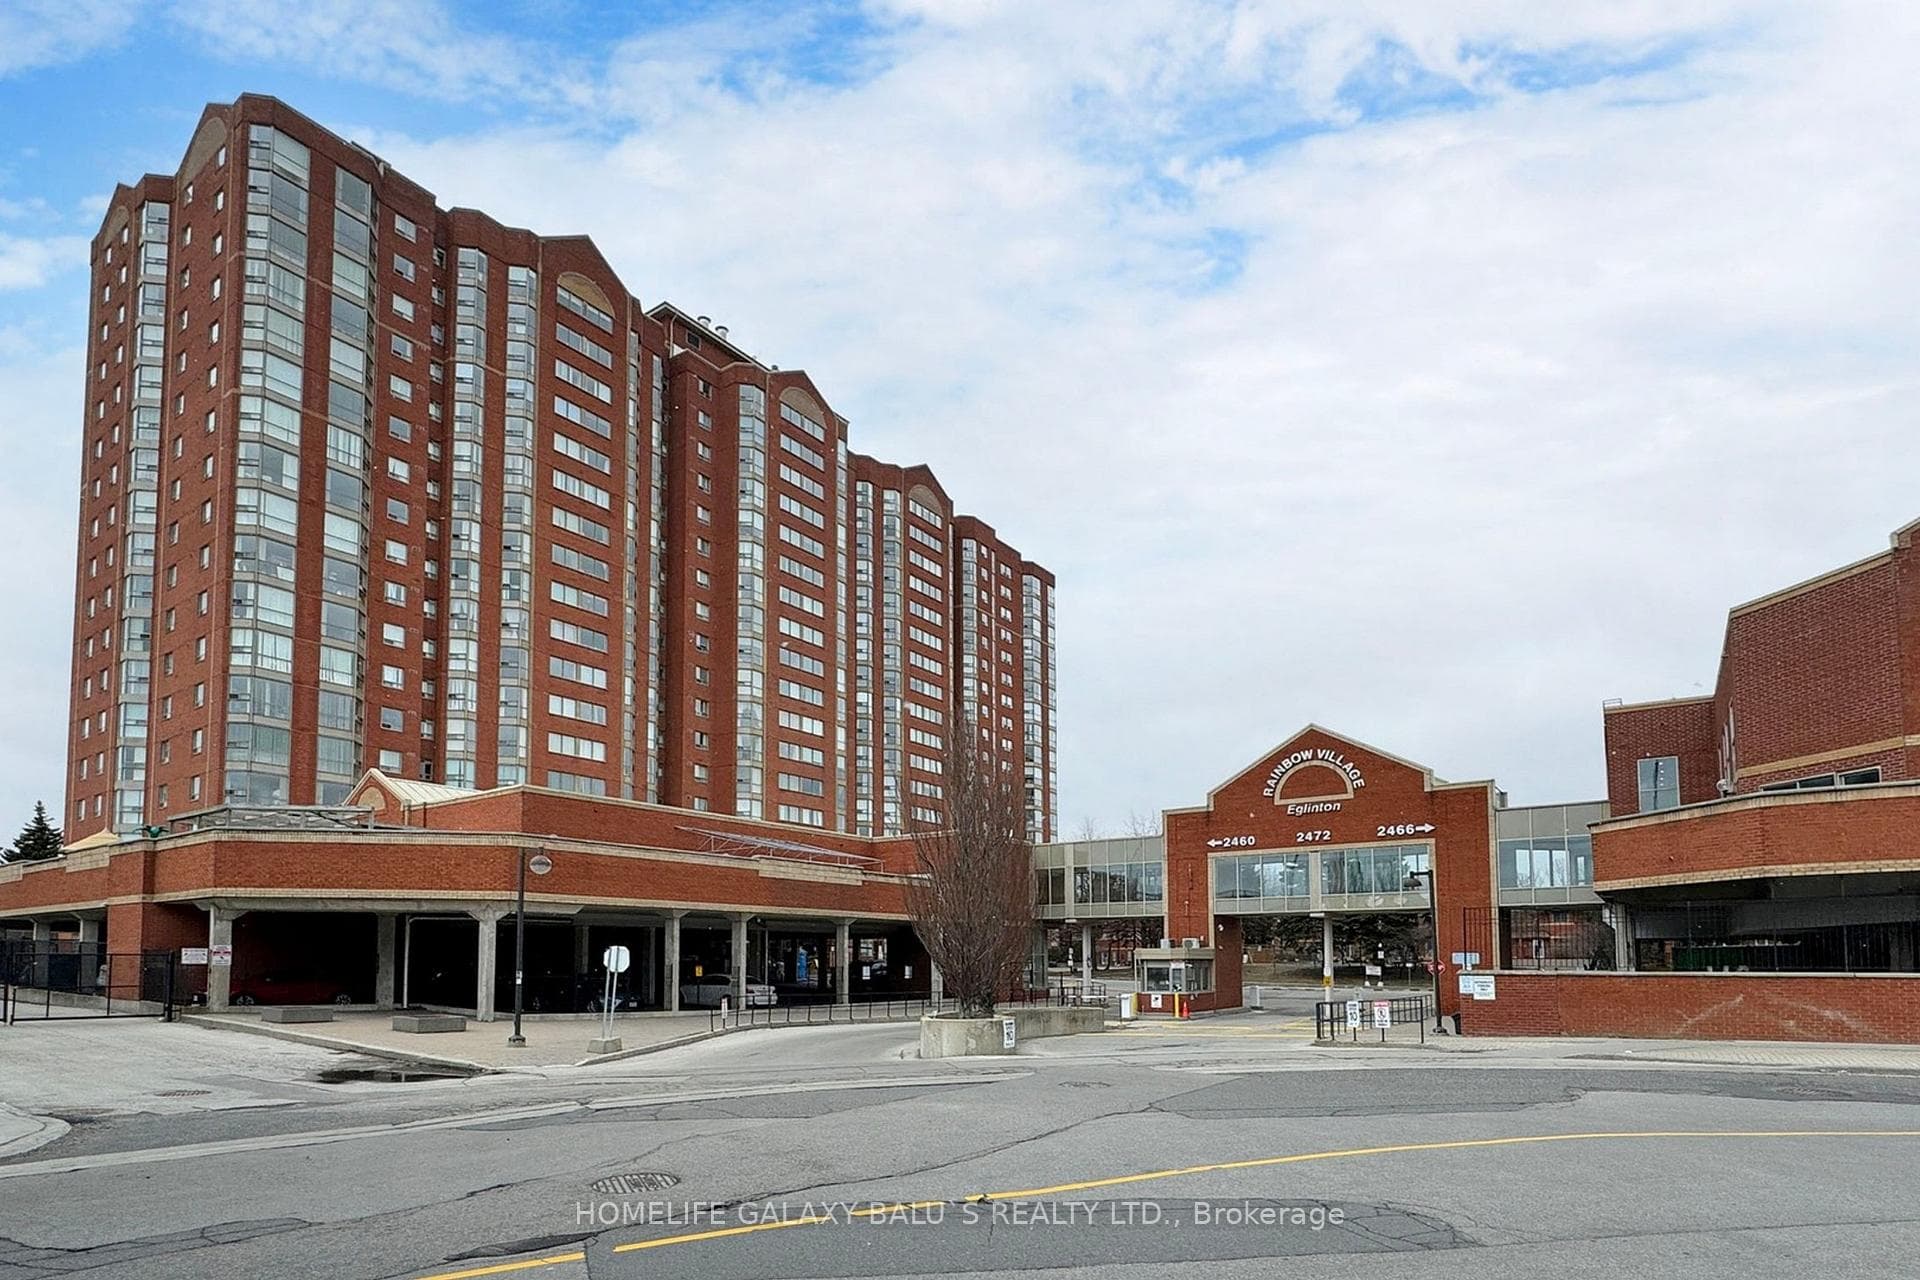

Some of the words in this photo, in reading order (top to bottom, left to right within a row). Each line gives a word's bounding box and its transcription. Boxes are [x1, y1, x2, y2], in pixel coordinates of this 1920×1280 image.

[1264, 749, 1314, 797] RAINBOW
[1317, 749, 1365, 789] VILLAGE
[1287, 802, 1341, 816] Eglinton
[1296, 830, 1332, 843] 2472
[1377, 824, 1415, 837] 2466
[1223, 836, 1256, 848] 2460
